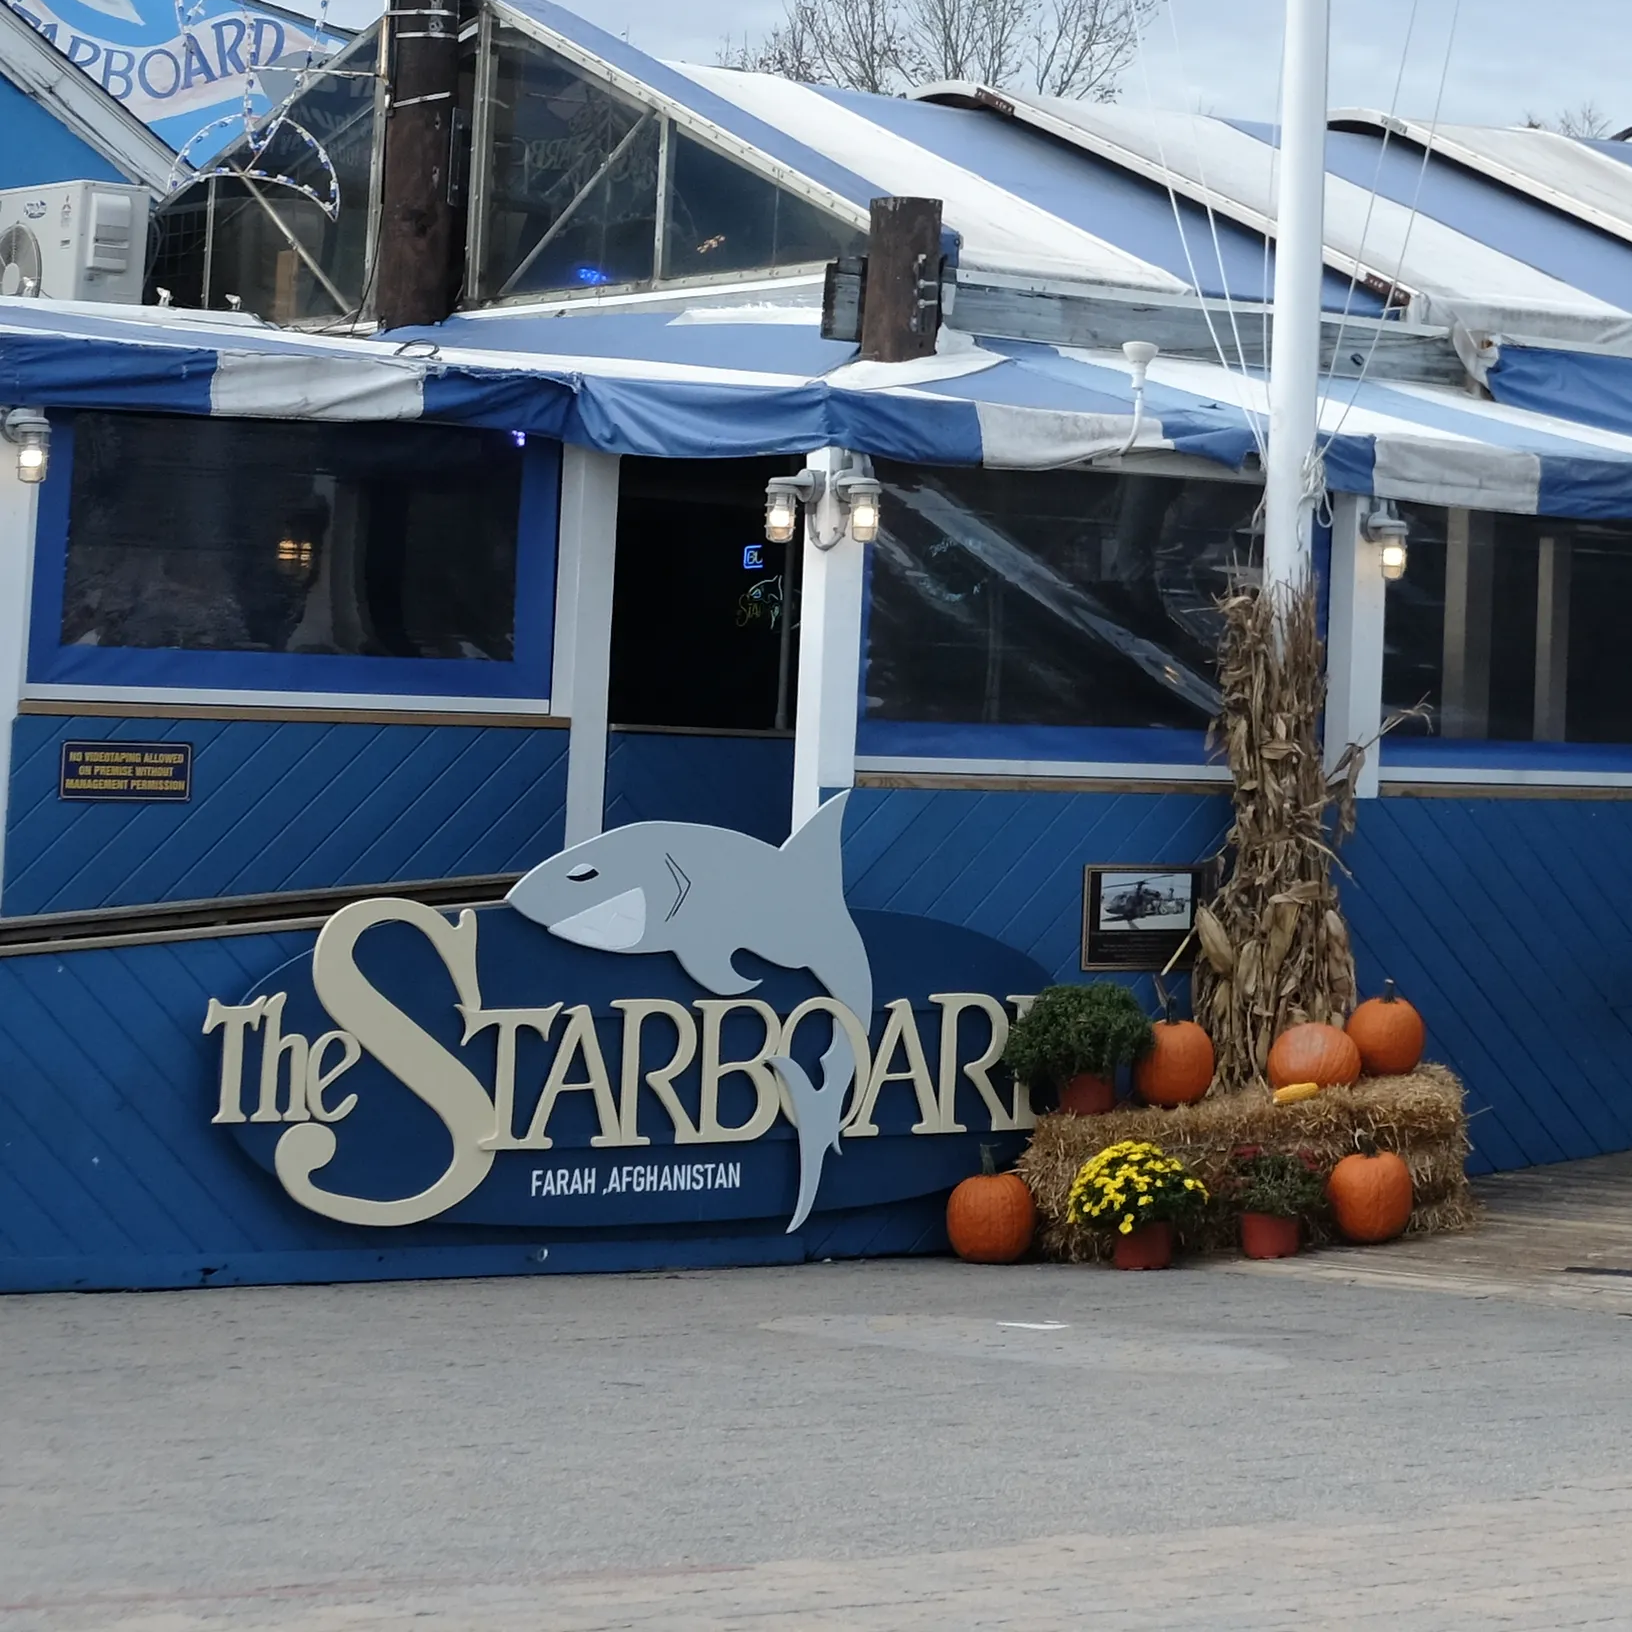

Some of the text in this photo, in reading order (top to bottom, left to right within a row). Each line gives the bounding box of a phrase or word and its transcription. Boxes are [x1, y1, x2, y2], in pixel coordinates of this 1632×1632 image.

[69, 751, 185, 764] NO VIDEOTAPING ALLOWED
[78, 765, 174, 777] ON PREMISE WITHOUT
[65, 778, 186, 791] MANAGEMENT PERMISSION
[203, 991, 363, 1125] The
[531, 1167, 597, 1197] FARAH
